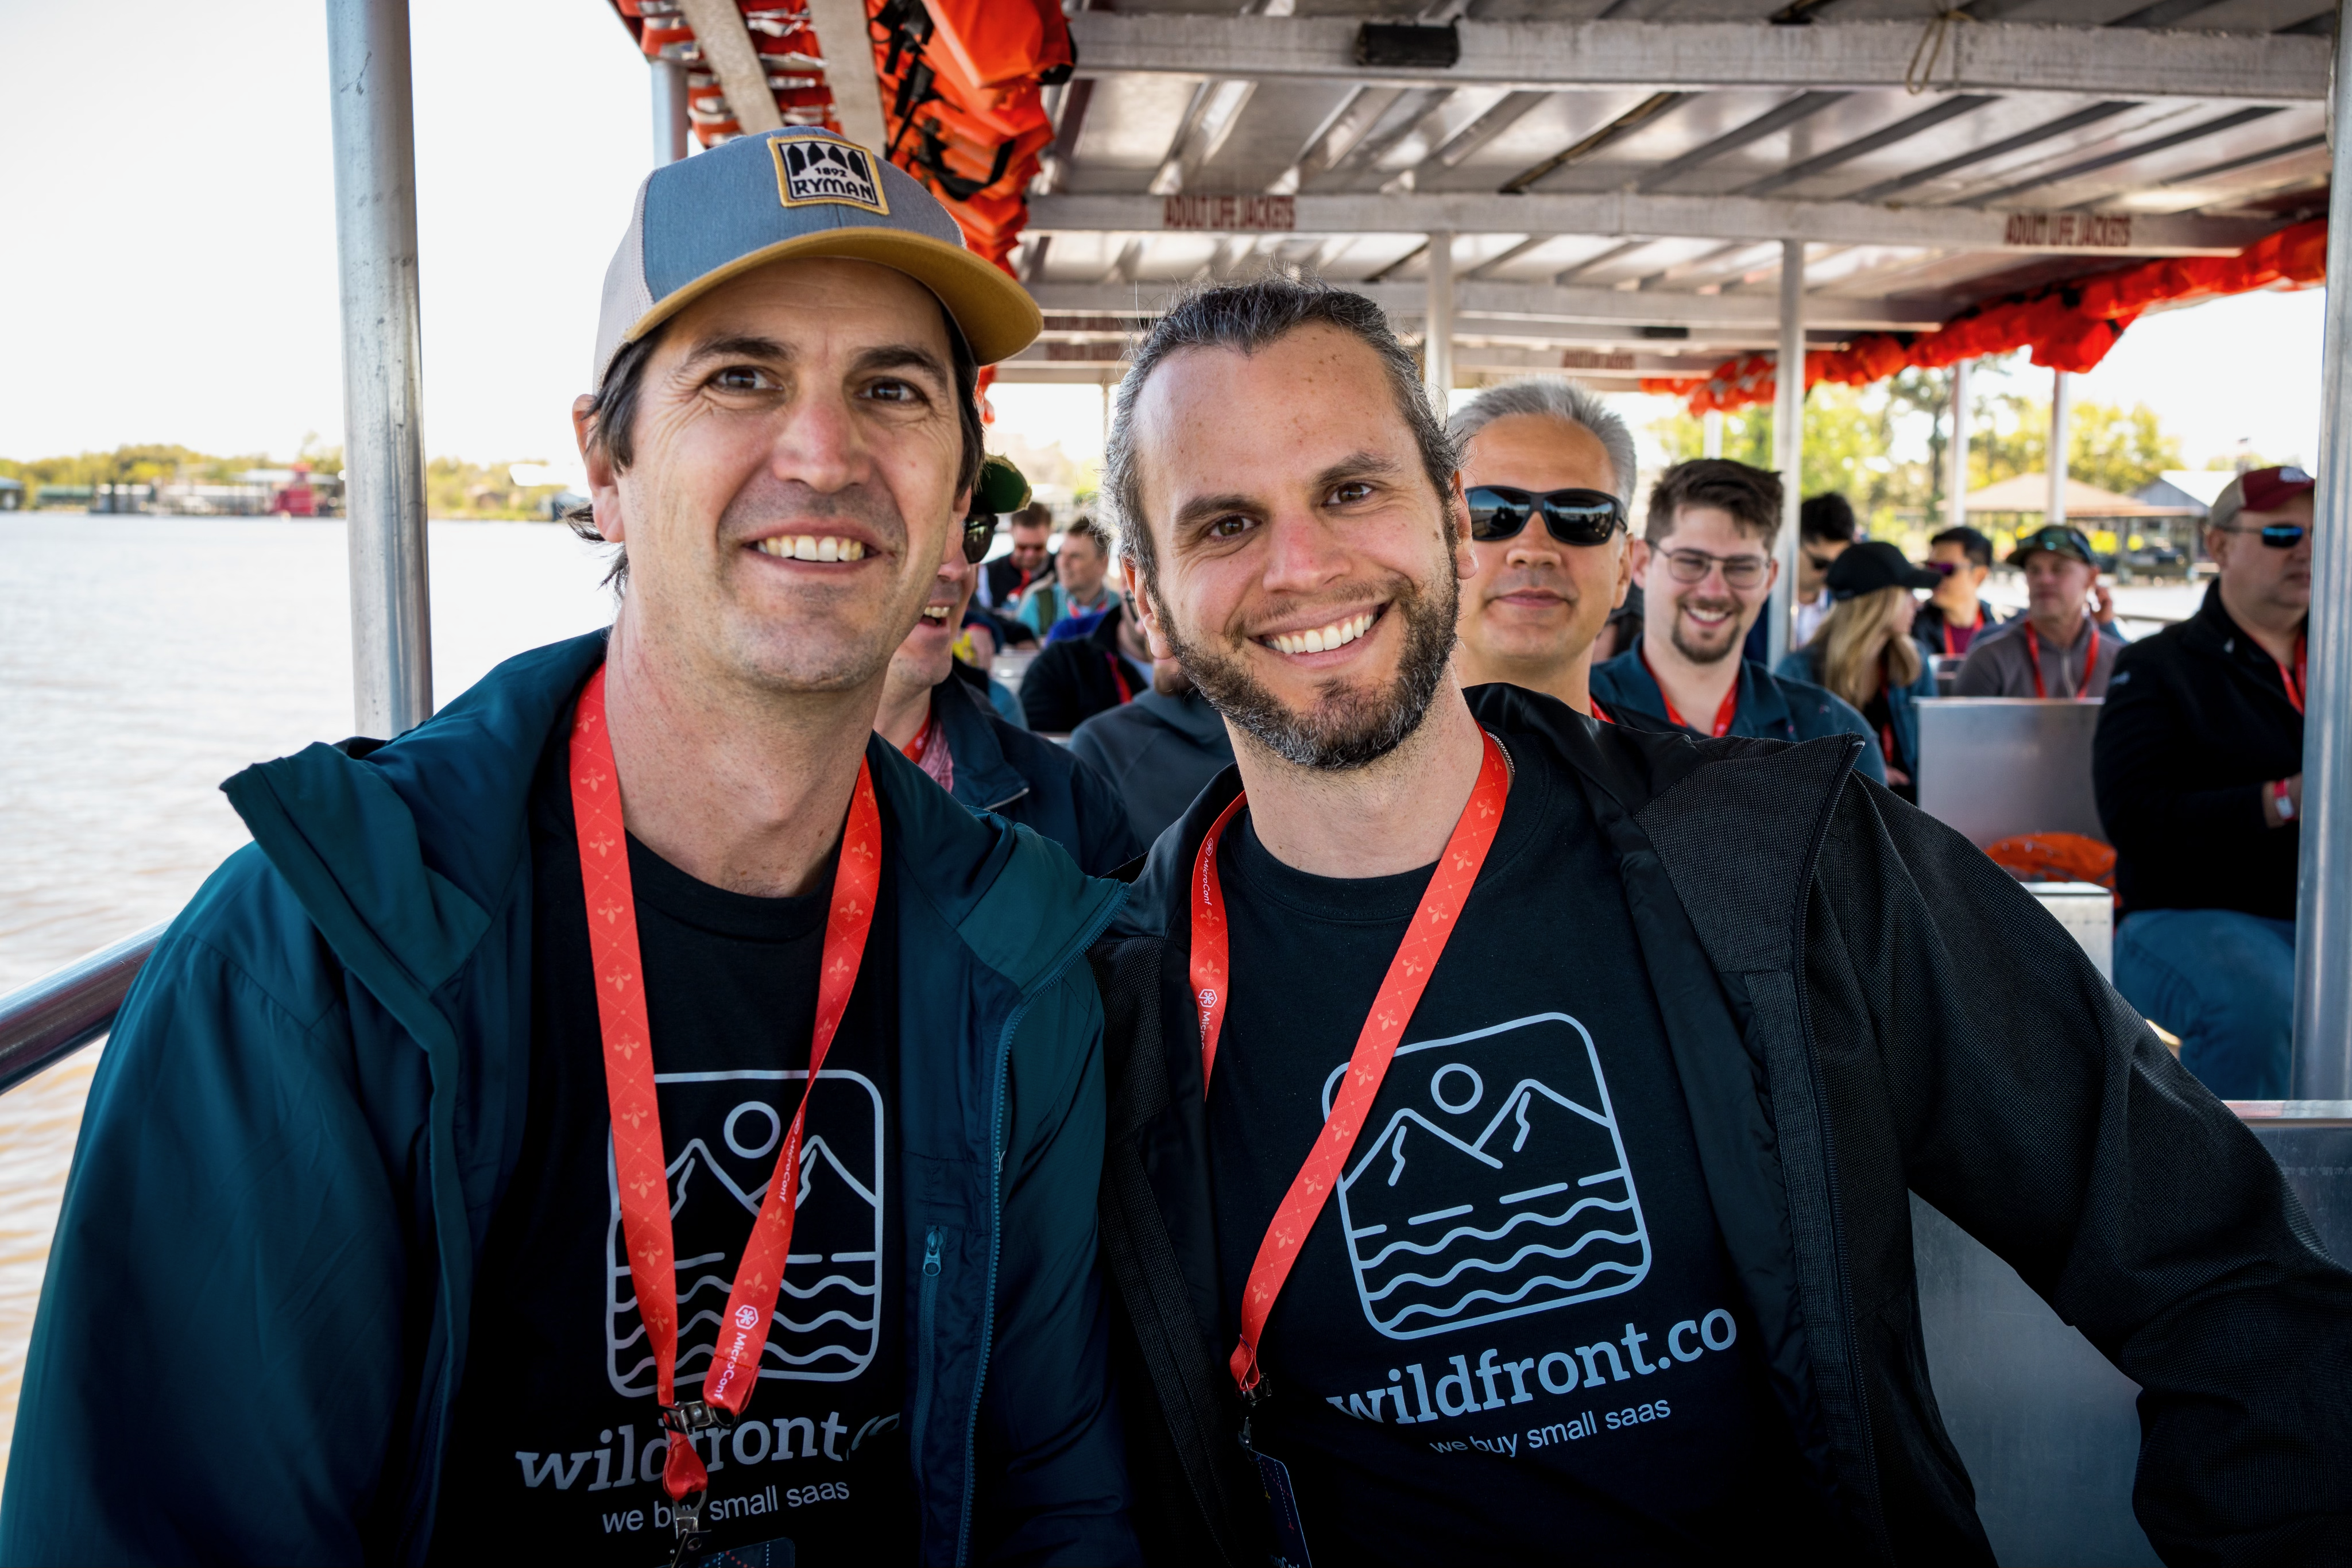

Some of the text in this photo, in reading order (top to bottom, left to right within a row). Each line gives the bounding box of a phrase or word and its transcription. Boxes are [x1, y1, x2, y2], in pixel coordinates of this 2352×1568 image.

[793, 178, 873, 200] RYMAN
[814, 167, 848, 177] 1892
[1203, 856, 1212, 906] MicroConf
[779, 1136, 796, 1202] MicroConf
[714, 1331, 747, 1400] MicroConf
[1325, 1308, 1737, 1424] wildfront.co
[1429, 1399, 1672, 1458] we buy small saas
[602, 1509, 644, 1534] we
[709, 1485, 779, 1521] small
[786, 1481, 850, 1508] saas
